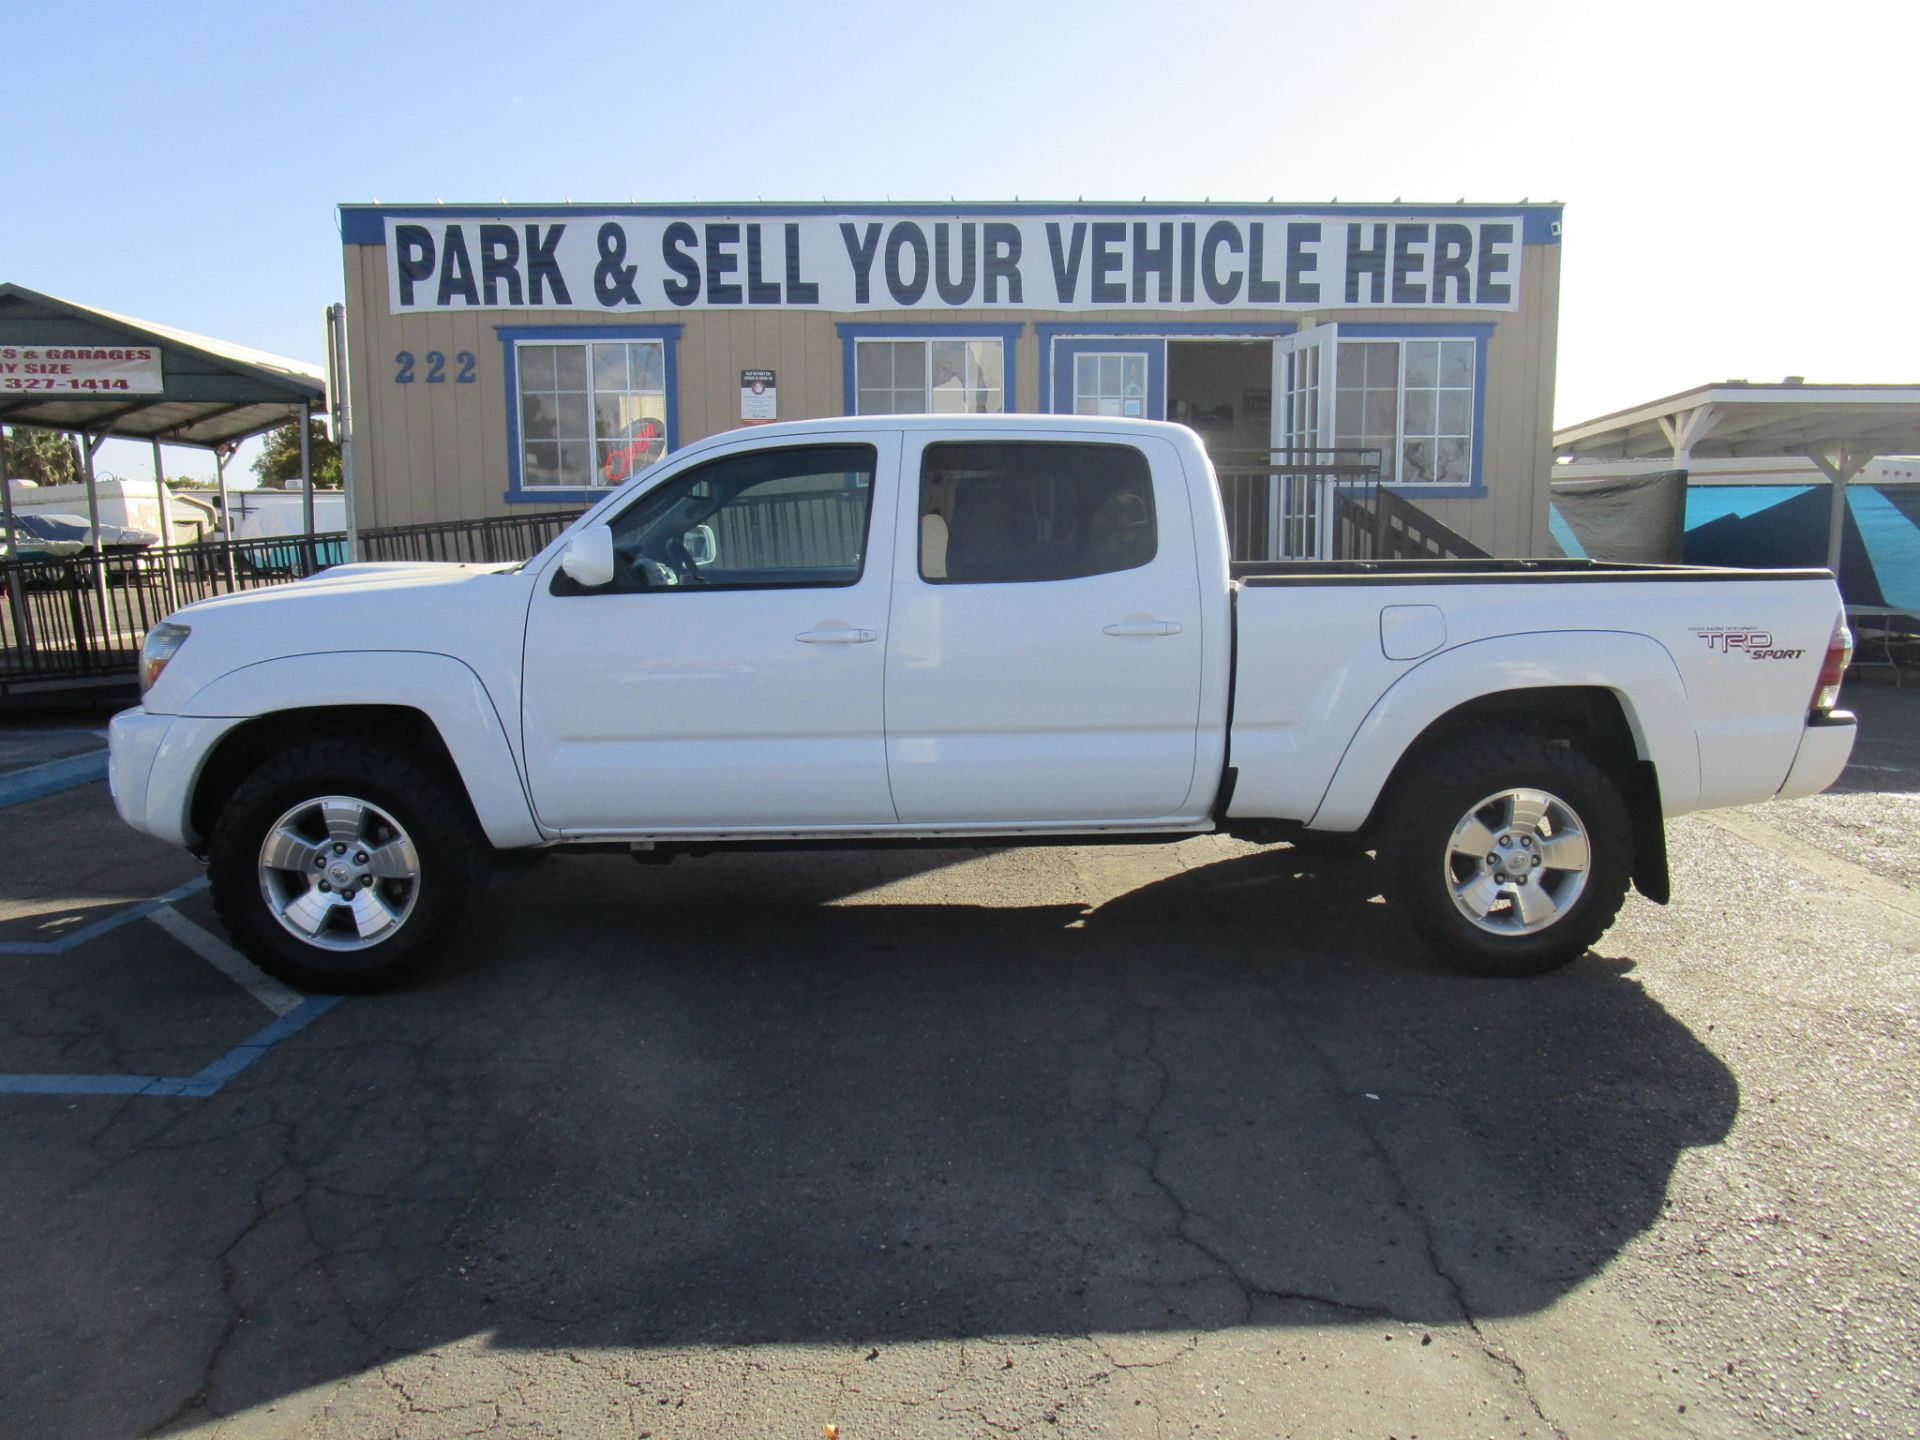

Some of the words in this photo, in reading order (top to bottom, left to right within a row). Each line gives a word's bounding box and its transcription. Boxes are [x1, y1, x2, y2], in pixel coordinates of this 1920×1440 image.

[395, 223, 573, 306] PARK
[593, 221, 642, 307] &
[662, 221, 819, 306] SELL
[839, 221, 1024, 306] YOUR
[1045, 220, 1322, 305] VEHICLE
[1345, 222, 1513, 304] HERE
[23, 350, 39, 360] &
[46, 349, 152, 360] GARAGES
[24, 363, 72, 375] SIZE
[4, 378, 130, 390] 327-1414
[1697, 631, 1773, 654] TRD
[1751, 649, 1805, 660] SPORT
